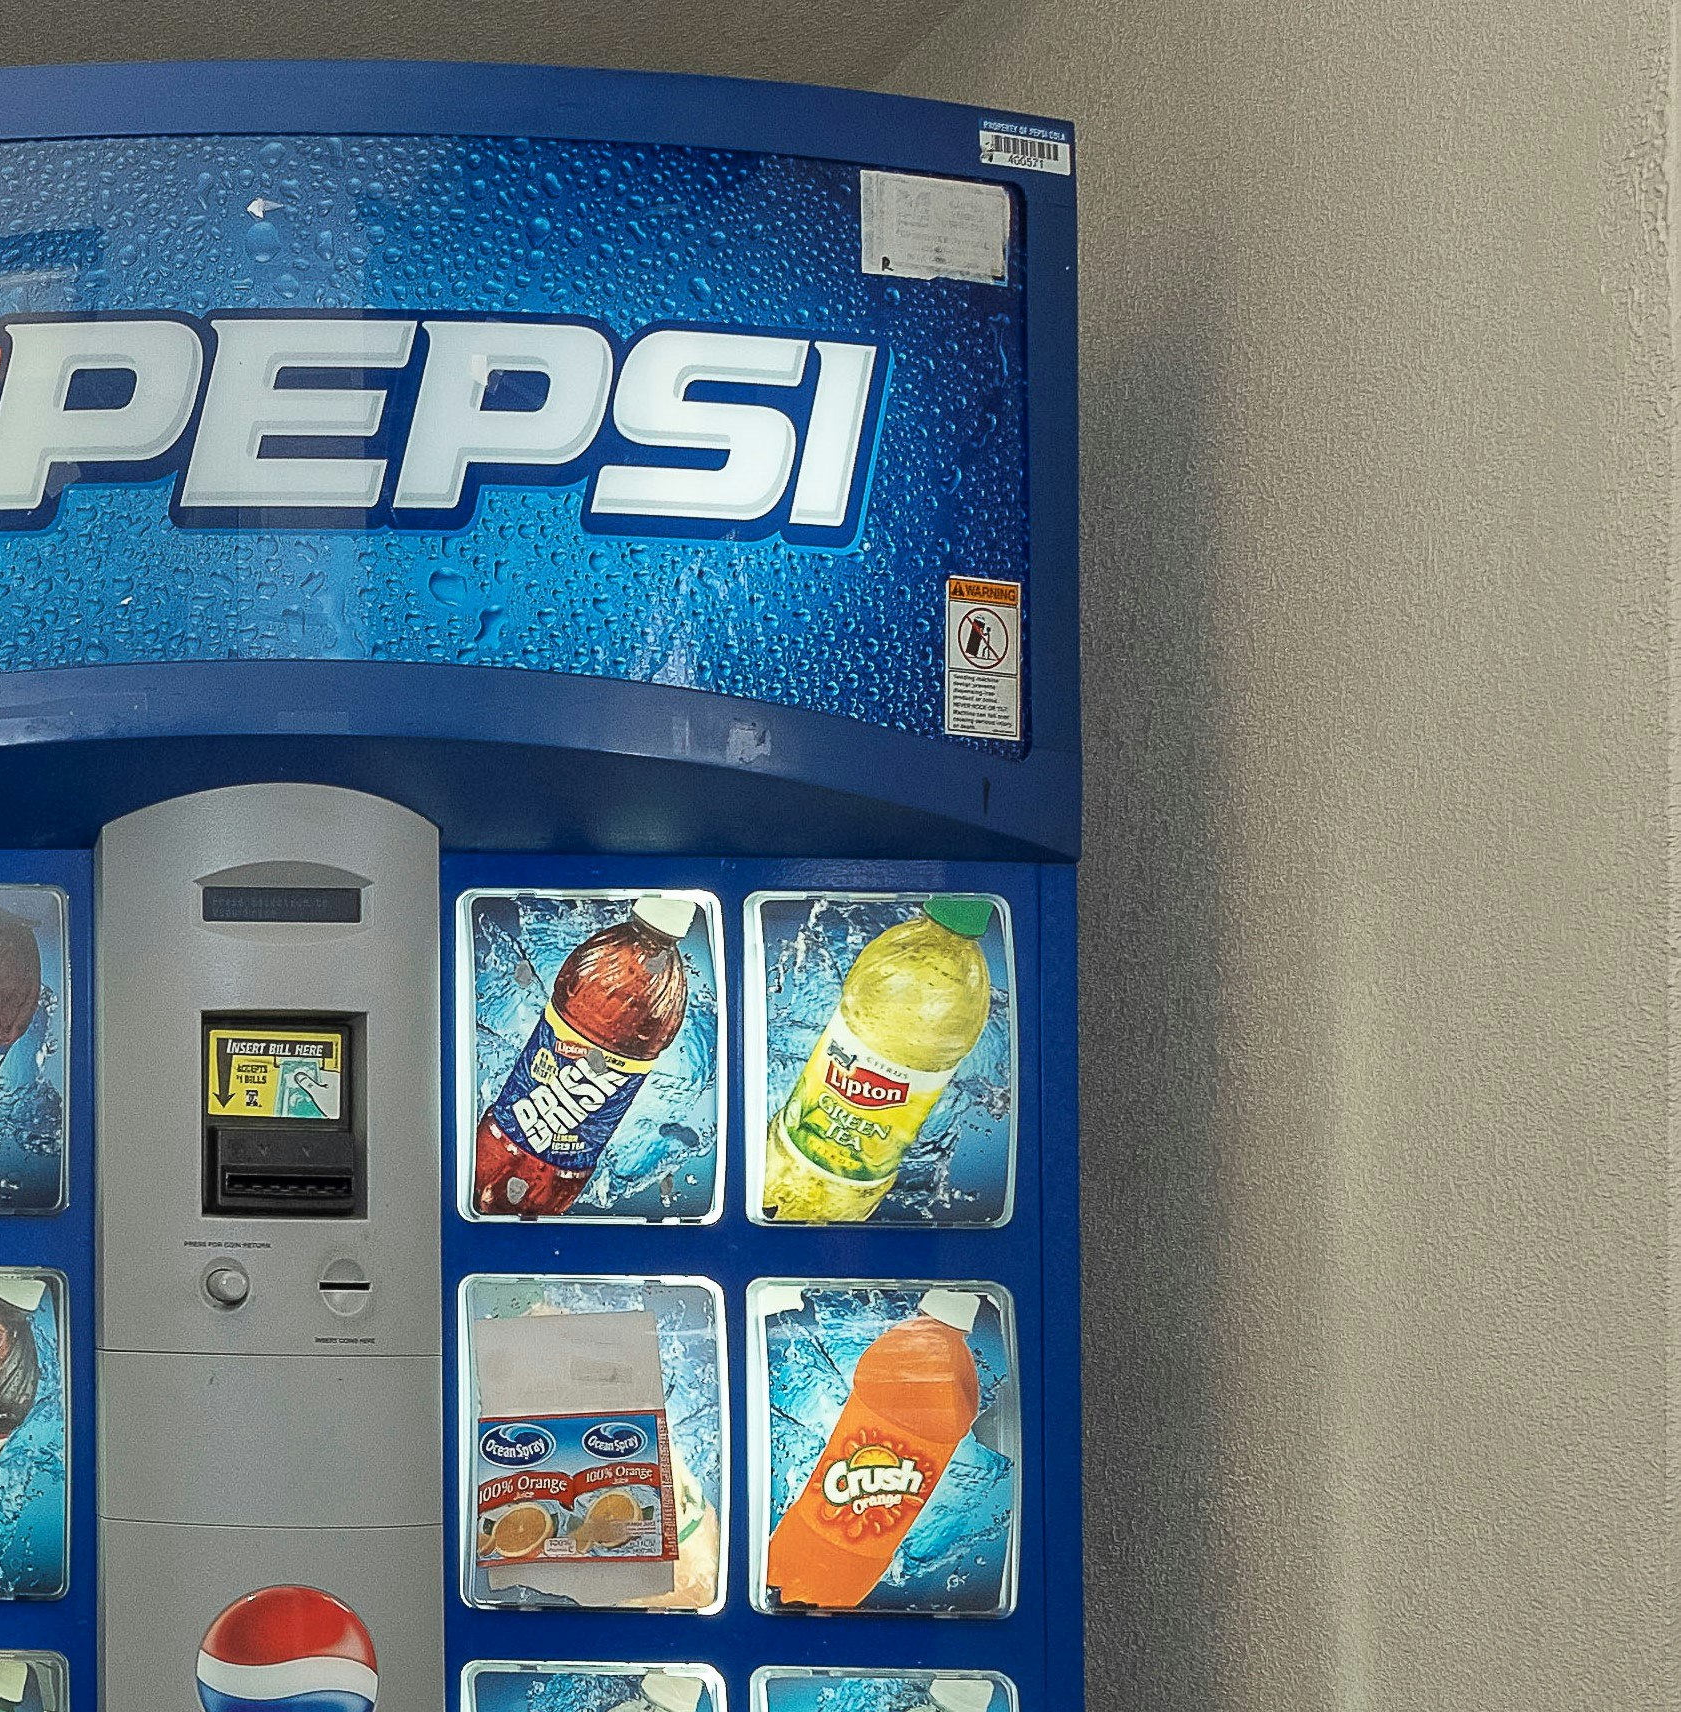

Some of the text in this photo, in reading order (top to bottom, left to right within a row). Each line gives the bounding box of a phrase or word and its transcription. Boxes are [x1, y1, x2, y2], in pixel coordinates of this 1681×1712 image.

[965, 585, 1016, 601] WARNING
[226, 1039, 324, 1056] INSERT BILL HERE
[557, 1041, 589, 1056] Lipton
[237, 1064, 268, 1073] ACCEPTS
[245, 1075, 267, 1085] BILLS
[829, 1067, 902, 1101] Lipton
[511, 1056, 631, 1154] BRISK
[819, 1092, 892, 1140] GREEN
[825, 1120, 862, 1151] TEA
[586, 1466, 654, 1484] 100% Orange
[822, 1458, 923, 1509] Crush
[479, 1475, 568, 1505] 100% Orange
[852, 1492, 903, 1516] Orange
